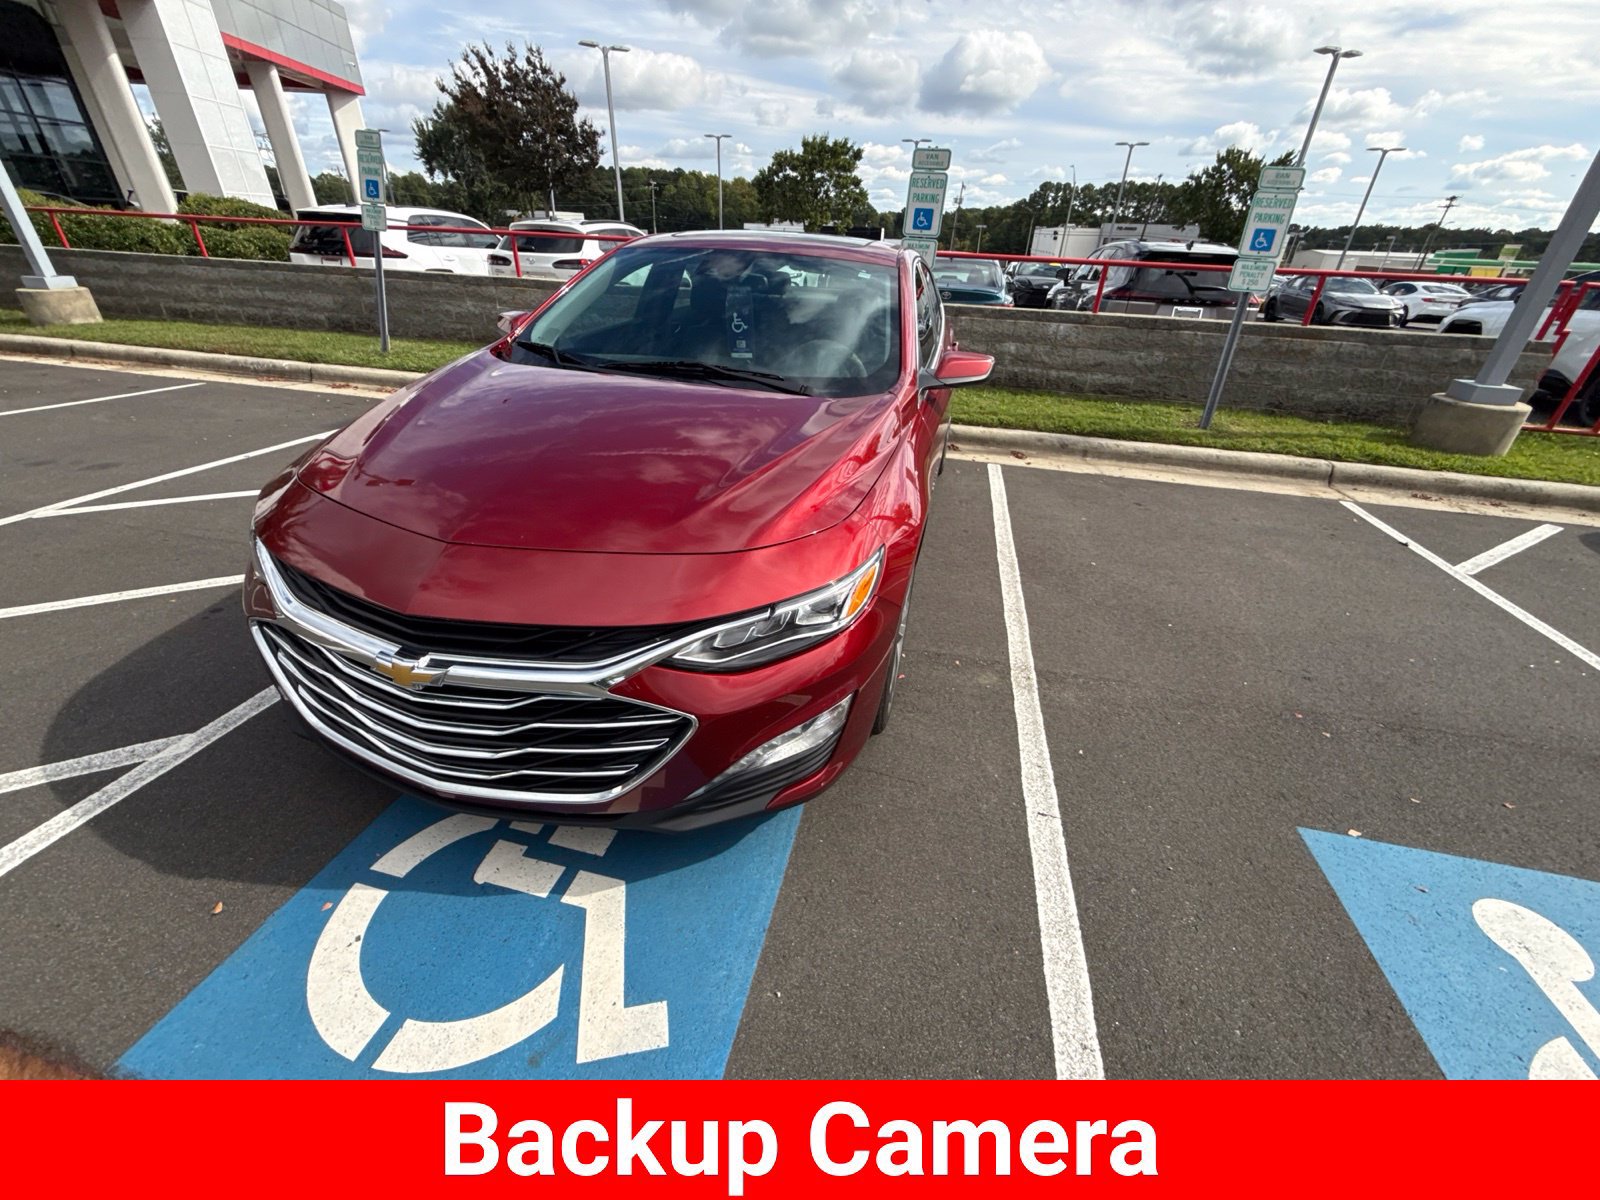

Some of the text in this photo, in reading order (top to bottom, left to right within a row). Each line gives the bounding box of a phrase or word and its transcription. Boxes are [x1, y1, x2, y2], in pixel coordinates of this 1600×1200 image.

[911, 177, 945, 189] RESERVED
[912, 192, 940, 203] PARKING
[1254, 197, 1295, 209] RESERVED
[1253, 212, 1286, 225] PARKING
[907, 242, 931, 250] MAXIMUM
[1241, 263, 1268, 271] MAXIMUM
[1239, 270, 1265, 279] PENALTY
